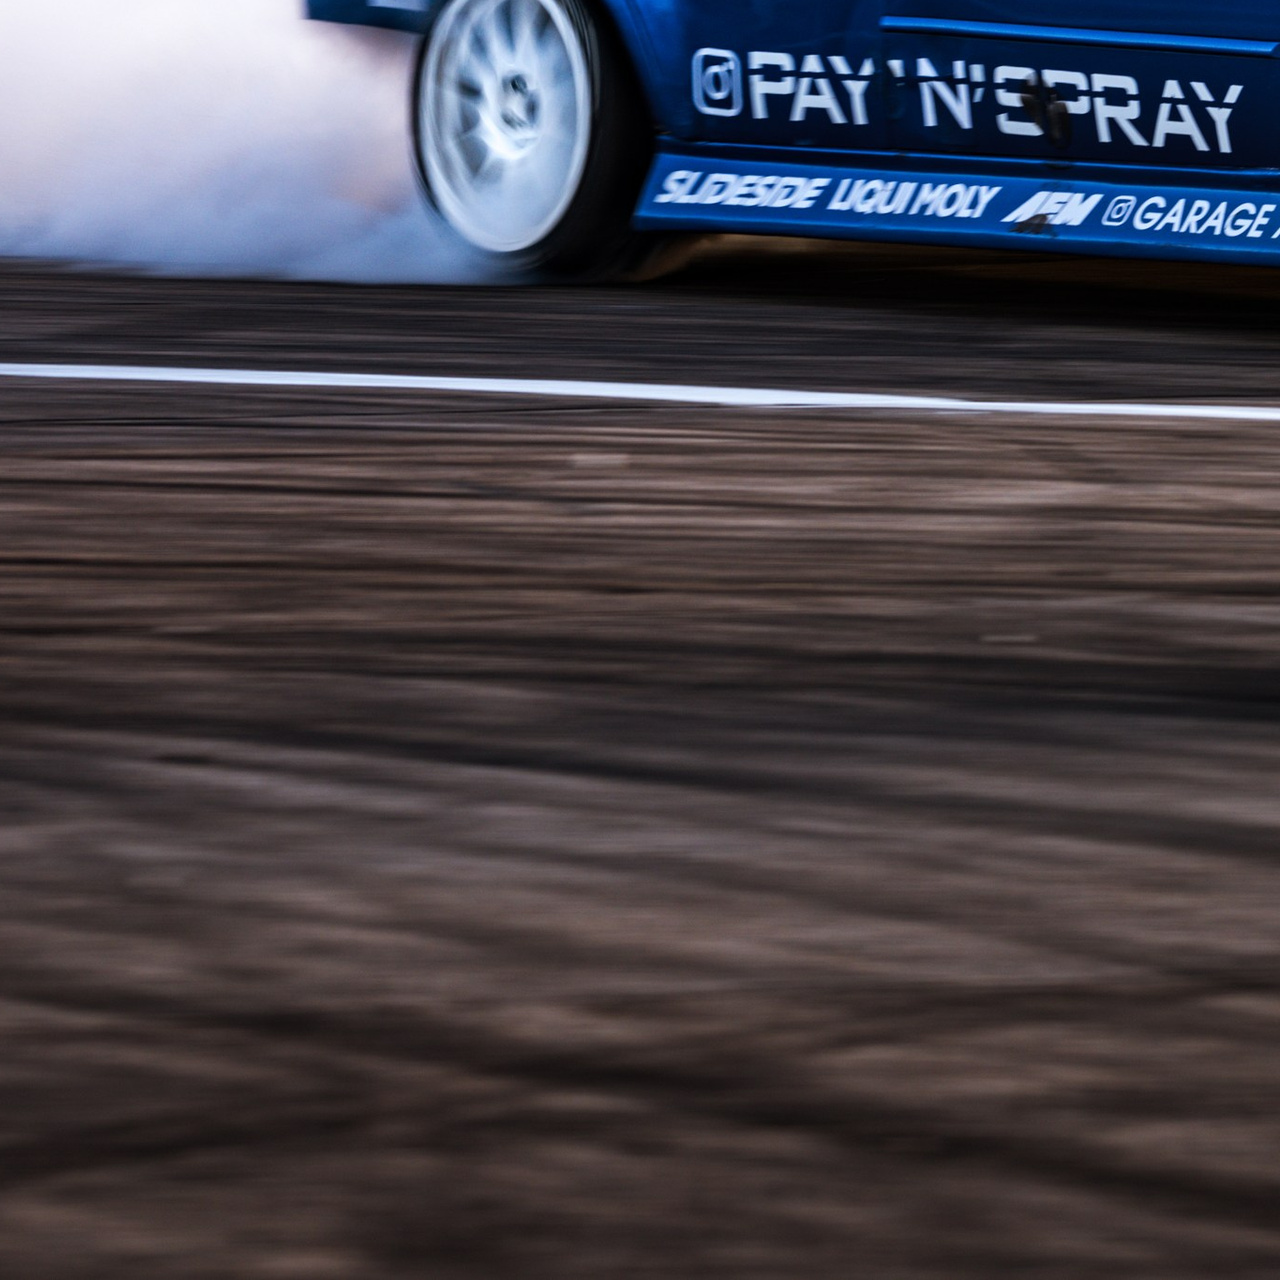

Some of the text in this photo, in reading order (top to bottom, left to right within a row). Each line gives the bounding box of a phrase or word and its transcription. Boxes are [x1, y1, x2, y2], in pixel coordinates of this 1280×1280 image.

[748, 51, 875, 125] PAY
[908, 184, 1002, 219] MOLY
[1133, 196, 1278, 238] GARAGE
